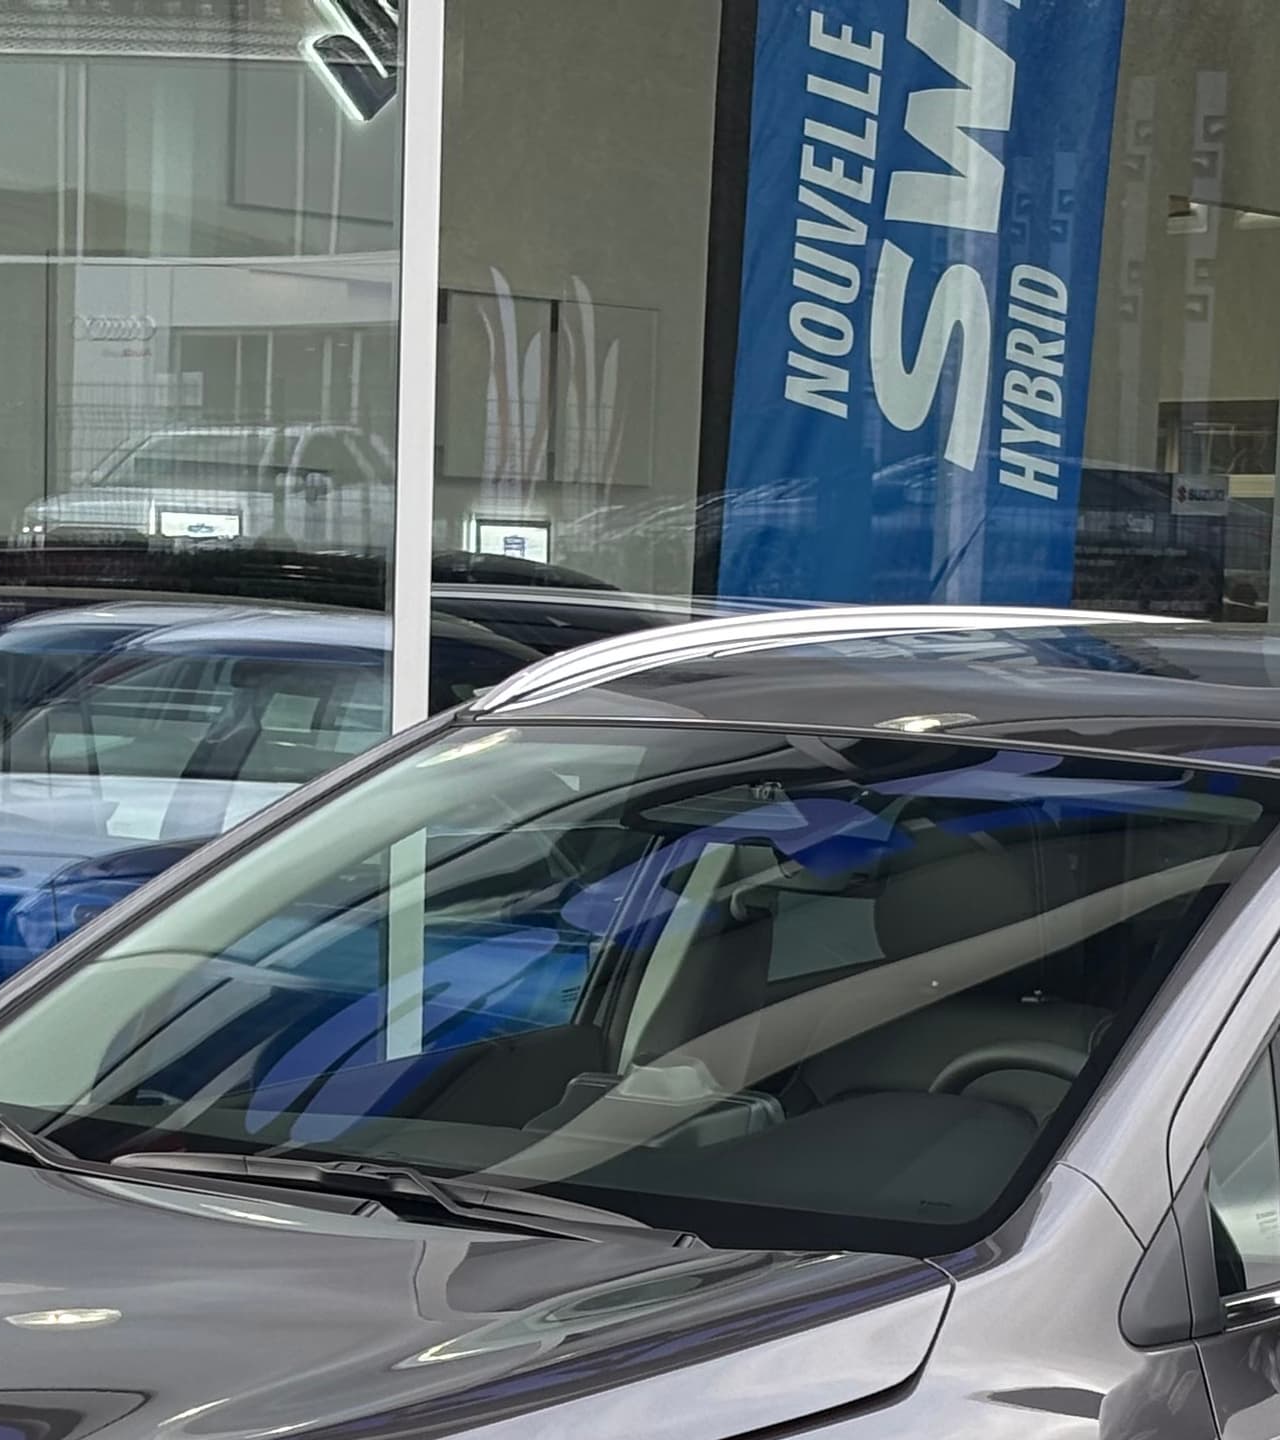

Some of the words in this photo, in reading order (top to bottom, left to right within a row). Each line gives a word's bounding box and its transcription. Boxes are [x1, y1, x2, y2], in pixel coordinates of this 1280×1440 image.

[784, 11, 885, 420] NOUVELLE
[870, 0, 1020, 473] SW
[999, 264, 1068, 501] HYBRID
